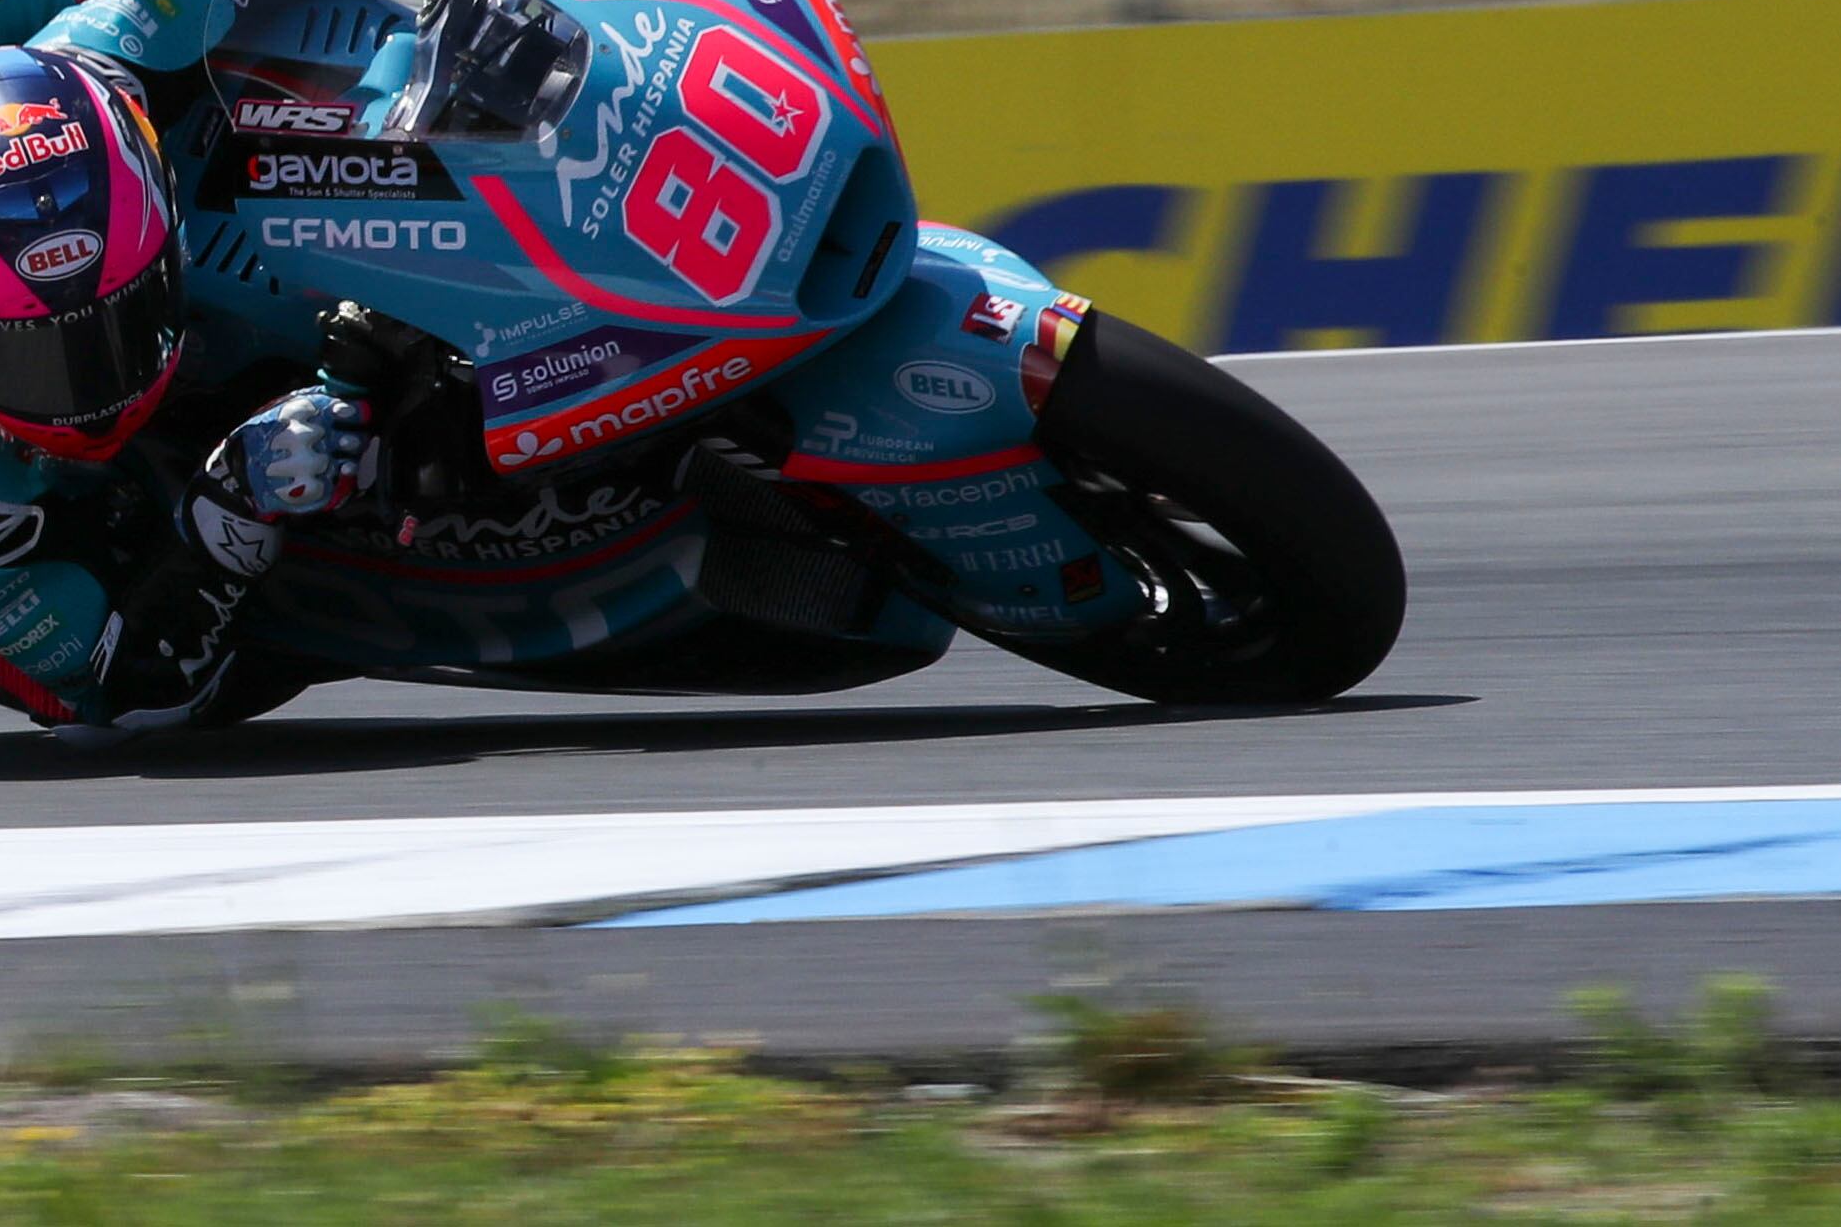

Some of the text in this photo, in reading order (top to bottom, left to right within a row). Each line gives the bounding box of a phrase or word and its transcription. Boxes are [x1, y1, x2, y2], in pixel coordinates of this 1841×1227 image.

[238, 103, 352, 133] WRS
[580, 142, 640, 241] SOLER
[631, 16, 696, 139] HISPANIA
[24, 120, 91, 165] Bull
[247, 153, 419, 191] gaviota
[621, 23, 834, 308] 80
[289, 186, 304, 197] The
[776, 149, 838, 264] azulmarino
[261, 217, 467, 251] CFMOTO
[26, 238, 95, 275] BELL
[48, 304, 94, 327] YOU
[499, 301, 588, 342] IMPULSE
[521, 340, 622, 387] solunion
[569, 355, 753, 446] mapfre
[909, 374, 982, 403] BELL
[858, 433, 935, 453] EUROPEAN
[899, 469, 1040, 510] facephi
[474, 496, 663, 562] HISPANIA
